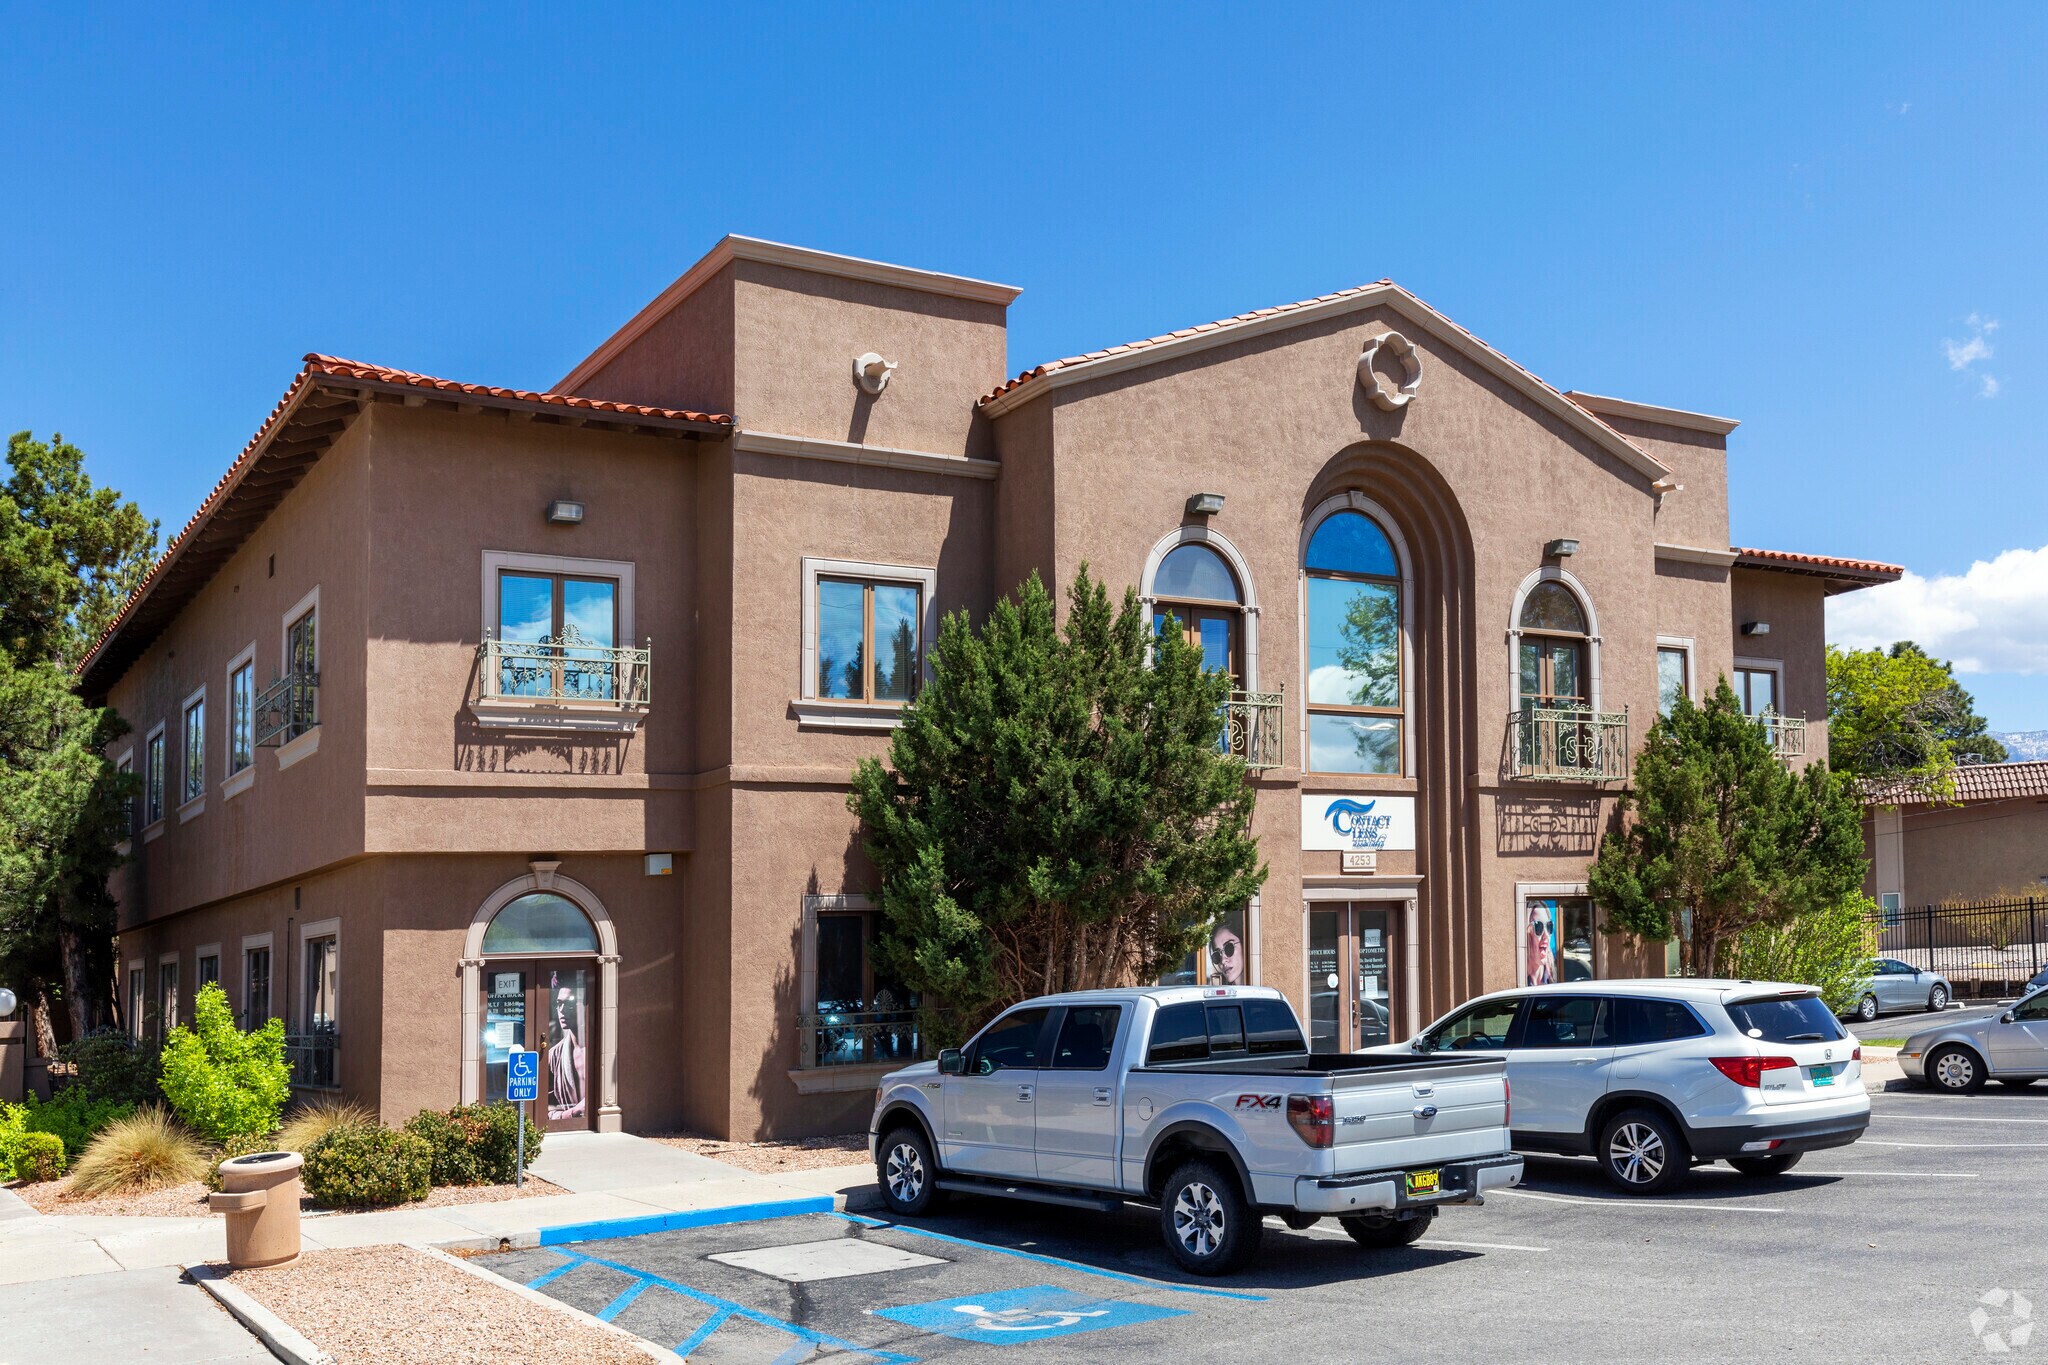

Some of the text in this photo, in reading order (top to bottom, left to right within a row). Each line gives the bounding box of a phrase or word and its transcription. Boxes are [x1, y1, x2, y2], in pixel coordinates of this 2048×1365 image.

[1352, 827, 1378, 840] LENS
[1349, 854, 1371, 866] 4253
[498, 979, 516, 989] EXIT
[509, 1076, 537, 1087] PARKING
[513, 1087, 531, 1098] ONLY
[1235, 1094, 1282, 1109] FX4
